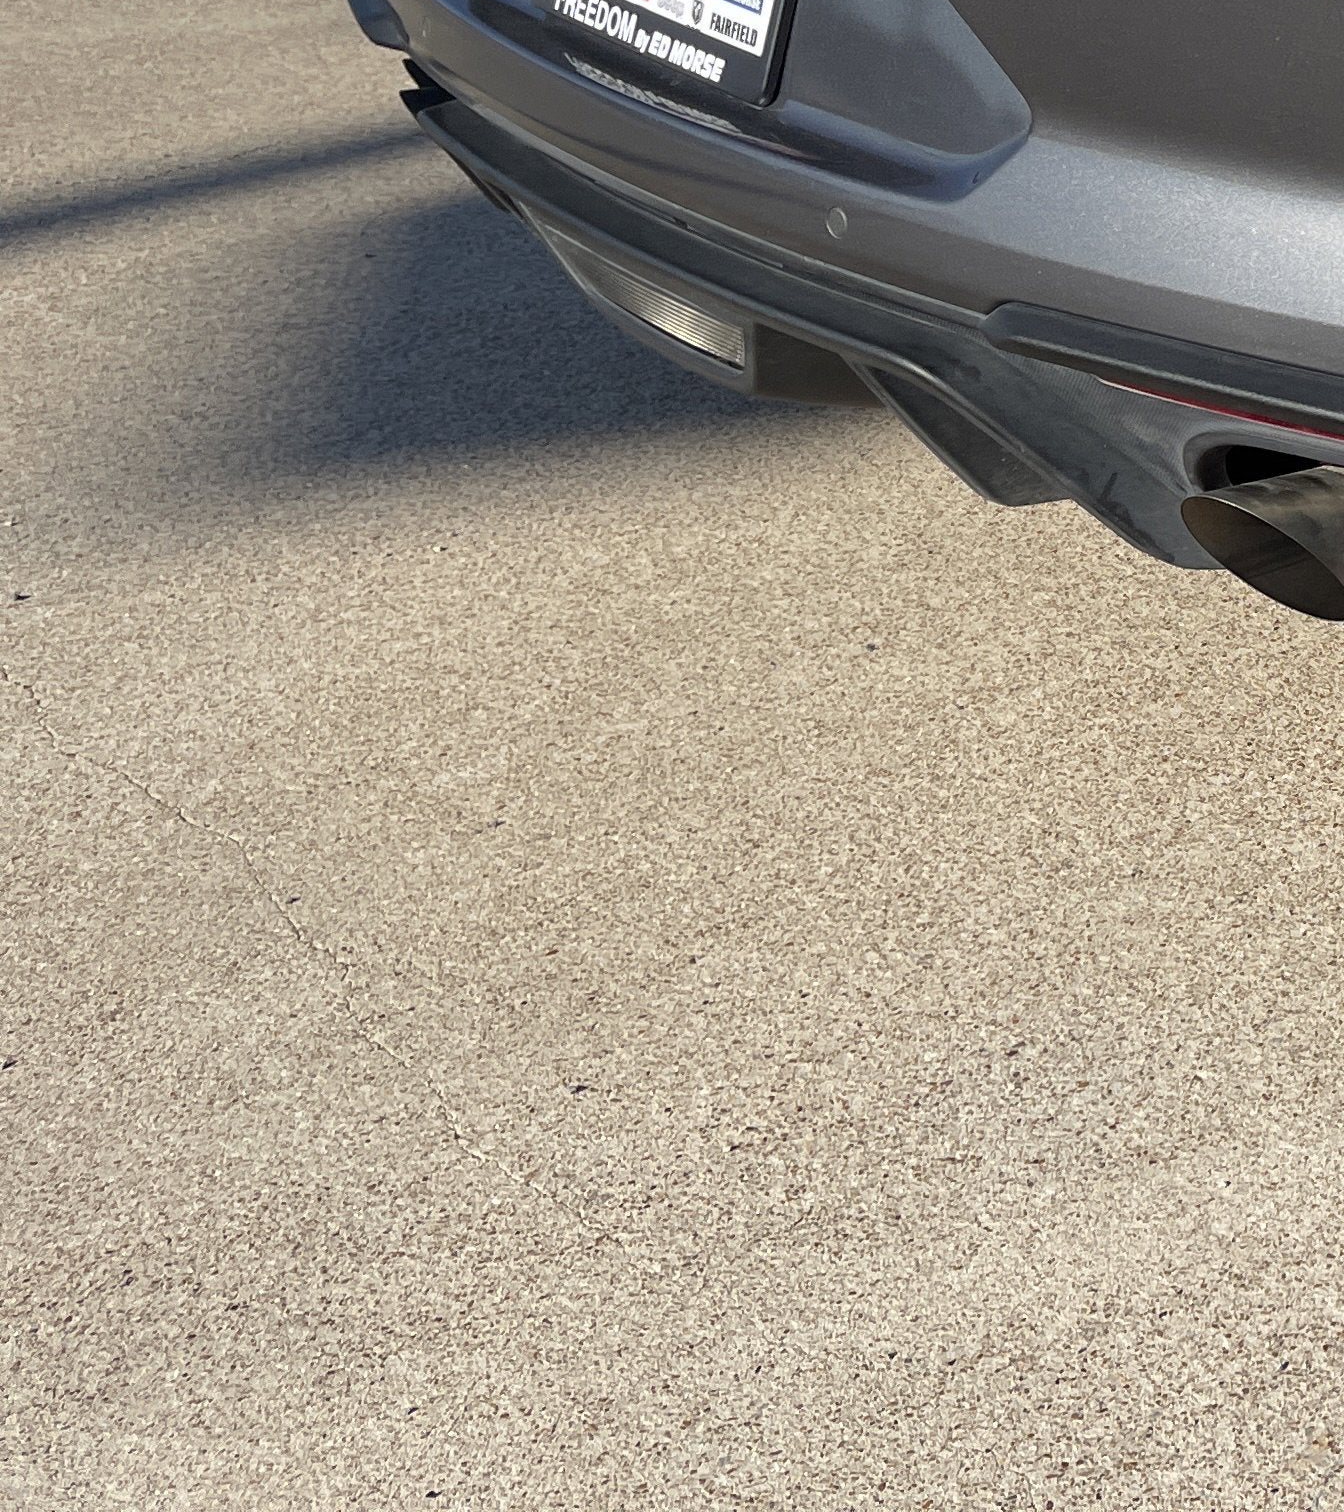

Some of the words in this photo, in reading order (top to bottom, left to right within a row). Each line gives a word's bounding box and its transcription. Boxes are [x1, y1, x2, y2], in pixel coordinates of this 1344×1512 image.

[709, 12, 758, 48] FAIRFIELD
[647, 31, 668, 61] ED
[666, 40, 726, 83] MORSE
